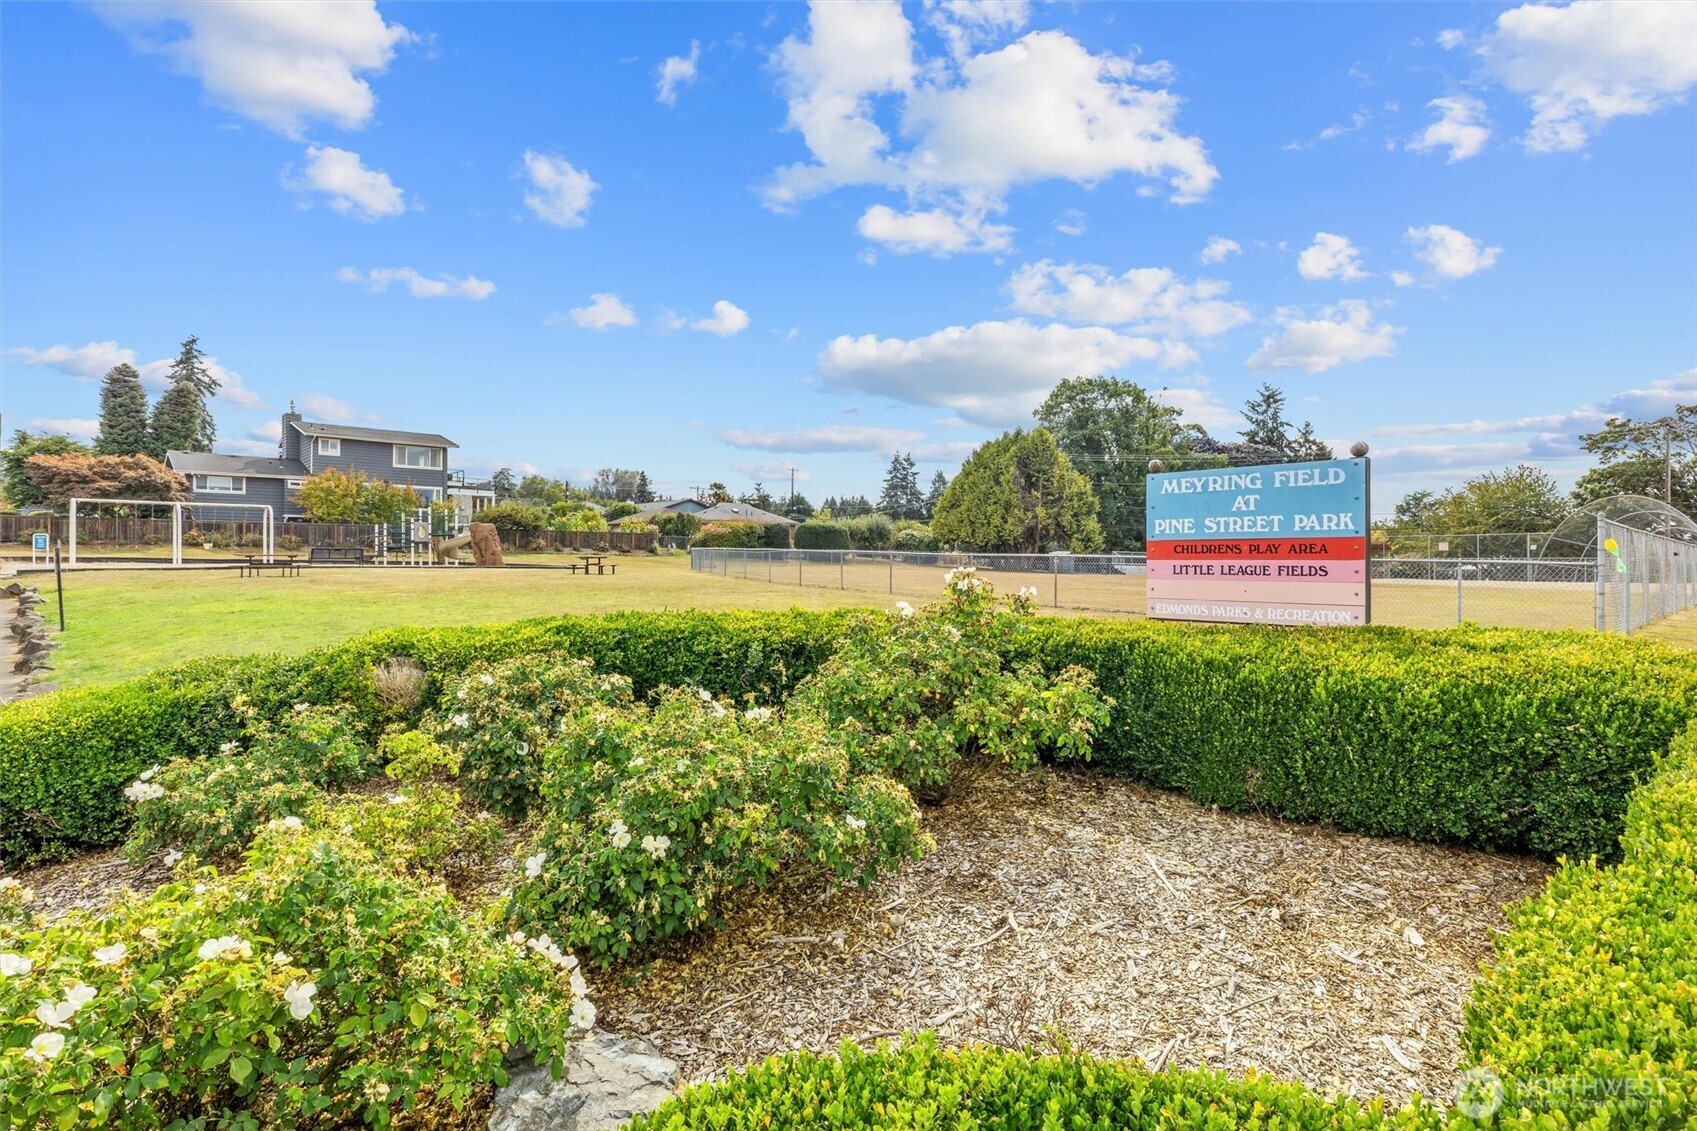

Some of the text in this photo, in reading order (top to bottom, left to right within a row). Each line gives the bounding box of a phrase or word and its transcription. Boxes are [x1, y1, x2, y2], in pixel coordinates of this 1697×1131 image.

[1161, 468, 1345, 494] MEYRING FIELD
[1231, 495, 1260, 511] AT
[1154, 513, 1354, 534] PINE STREET PARK
[1174, 544, 1328, 554] CHILDRENS PLAY AREA
[1173, 565, 1328, 577] LITTLE LEAGUE FIELDS
[1156, 604, 1351, 622] EDMONDS PARKS & RECREATION
